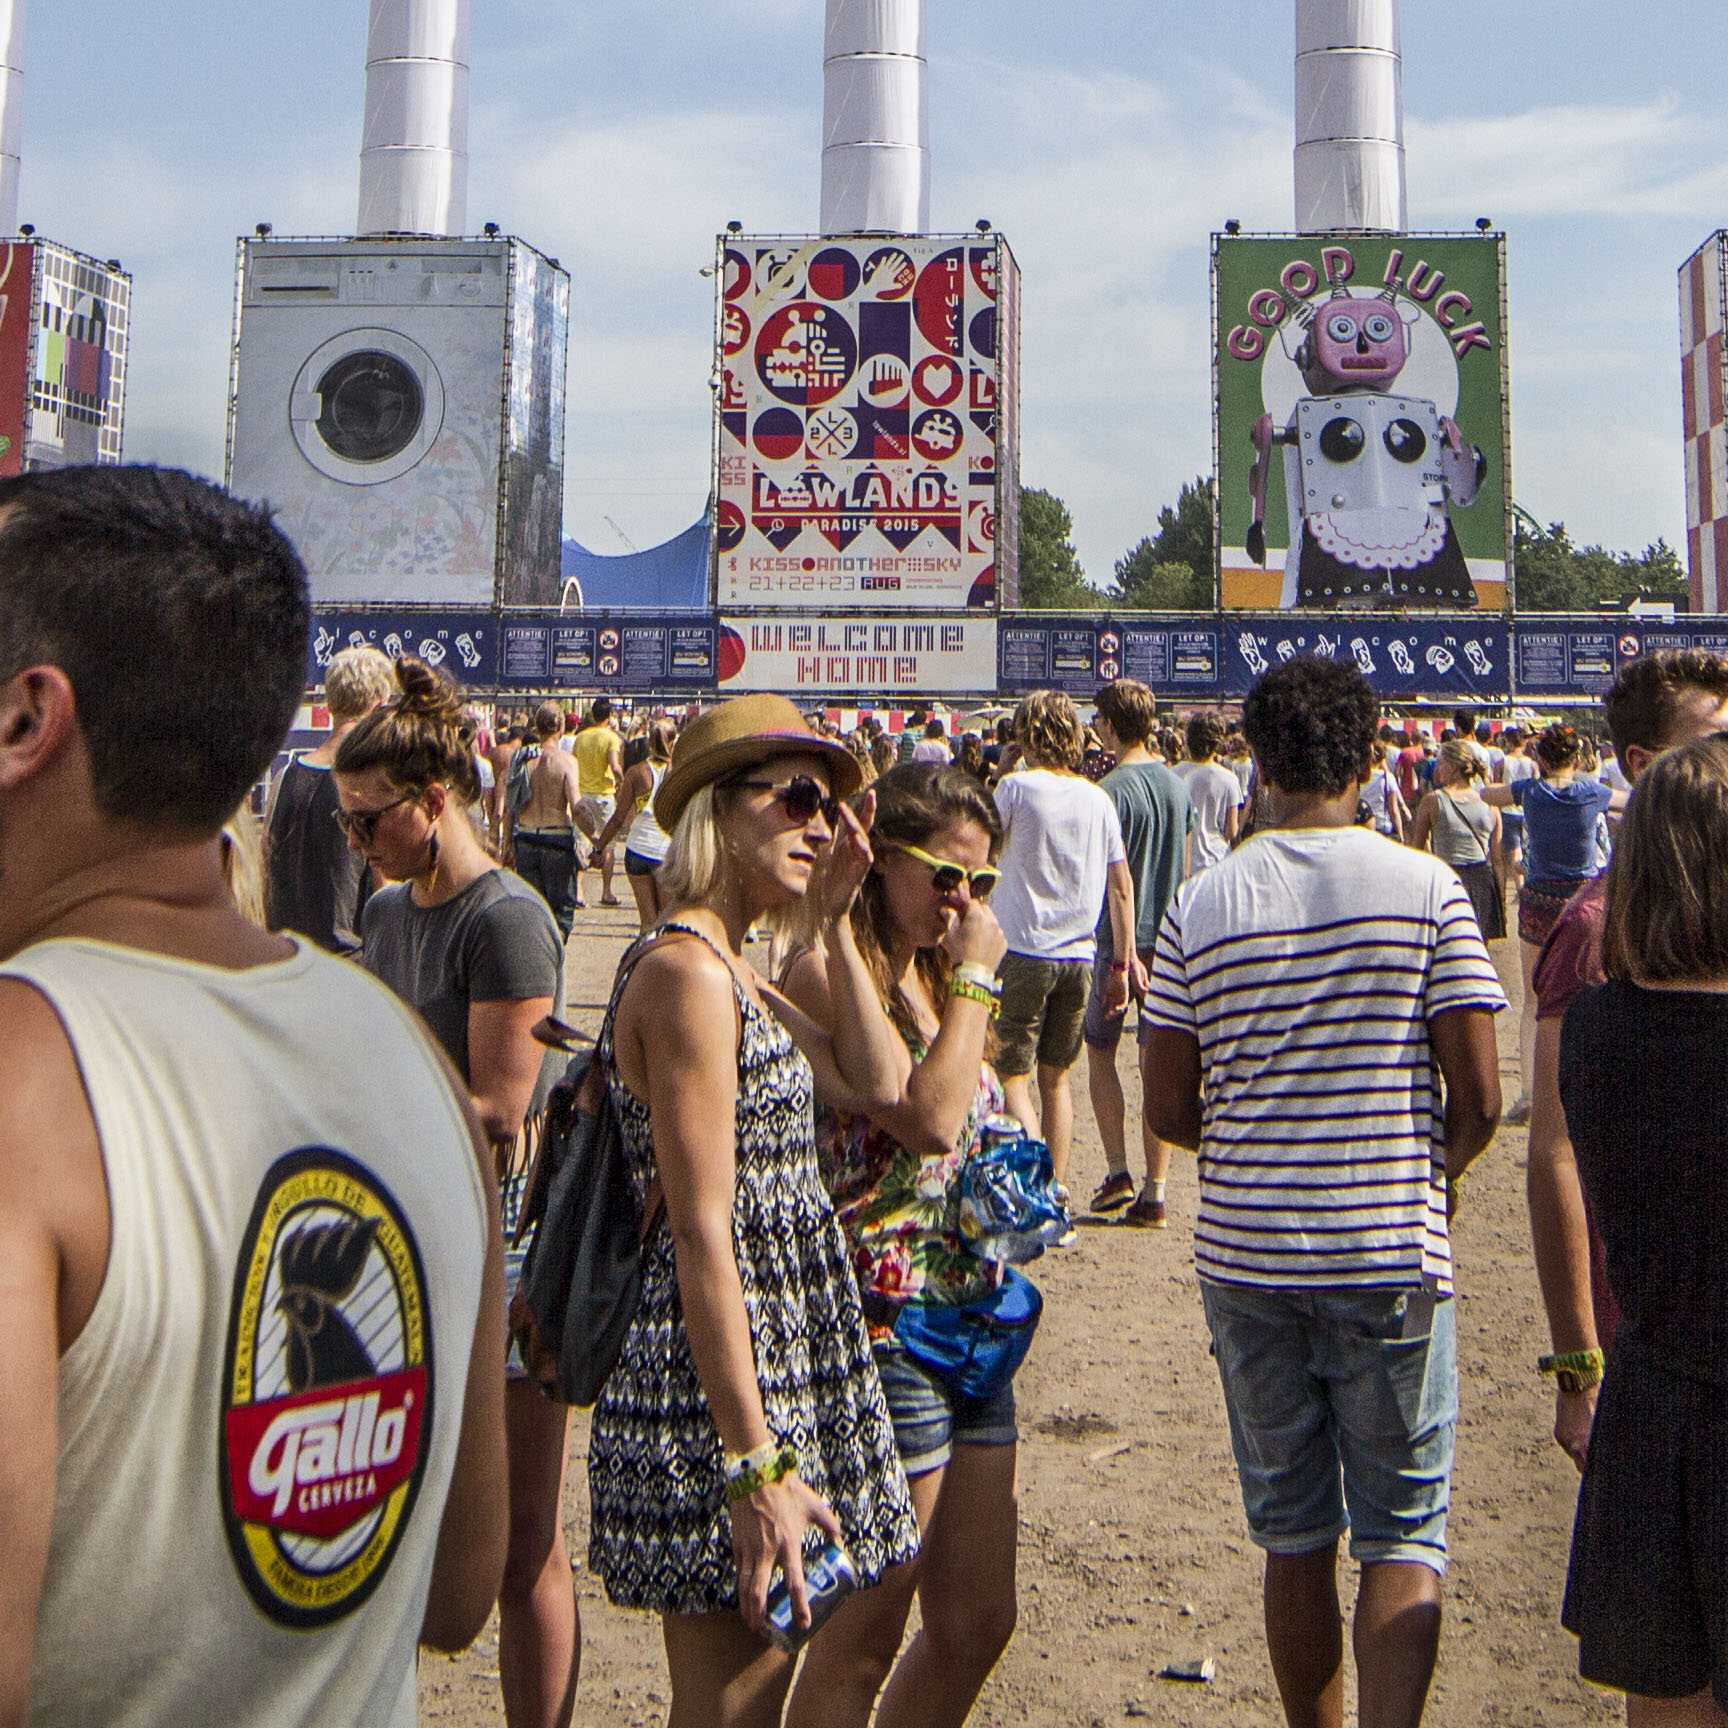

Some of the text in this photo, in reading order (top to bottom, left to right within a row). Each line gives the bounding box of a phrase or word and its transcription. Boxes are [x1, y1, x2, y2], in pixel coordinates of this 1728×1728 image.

[1227, 246, 1492, 361] GOOD LUCK
[884, 518, 920, 532] 2015
[750, 557, 801, 572] KISS
[923, 557, 962, 572] SKY
[749, 576, 900, 591] 21+22+23 AUG
[751, 625, 964, 652] WELCOME
[797, 656, 917, 684] HOME
[248, 1390, 407, 1518] Gallo
[298, 1471, 377, 1514] CERVEZA
